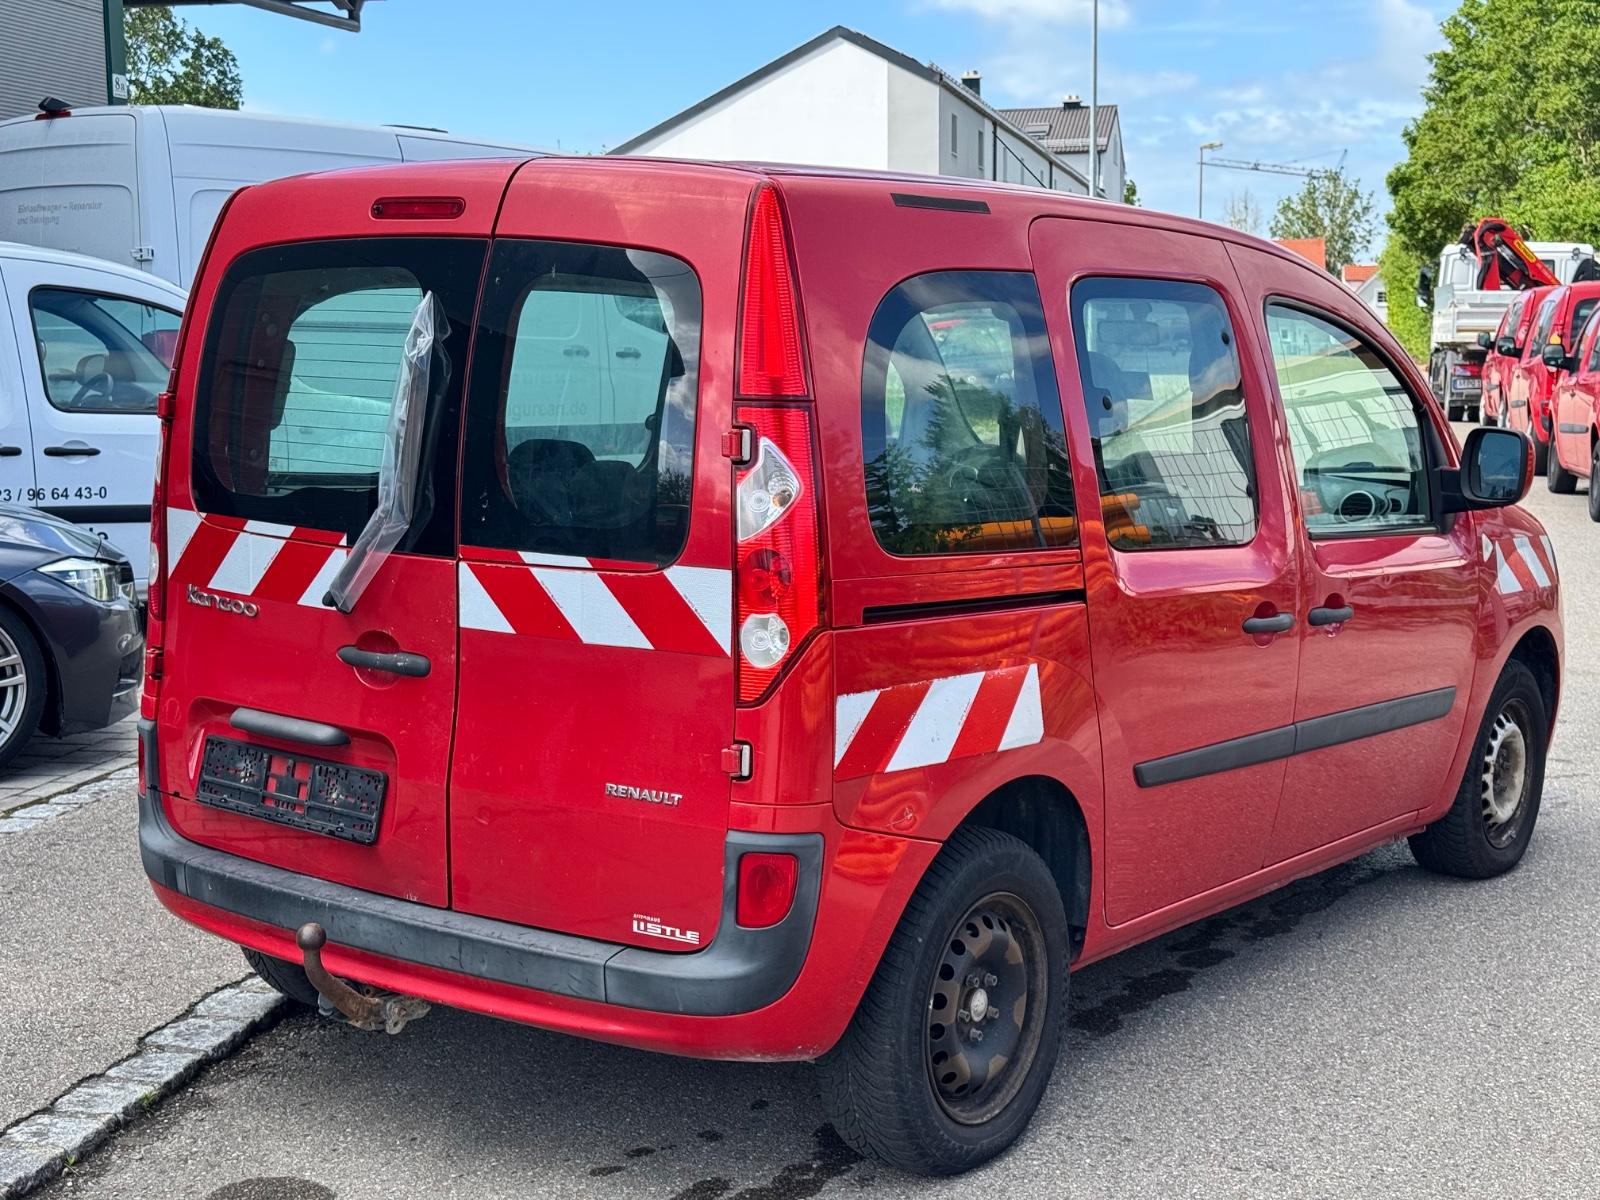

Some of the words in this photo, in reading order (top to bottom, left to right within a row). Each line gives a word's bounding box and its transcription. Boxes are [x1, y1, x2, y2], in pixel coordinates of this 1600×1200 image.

[0, 489, 12, 501] 3
[27, 488, 46, 501] 96
[51, 487, 69, 500] 64
[75, 486, 107, 499] 43-0
[605, 783, 682, 806] RENAULT
